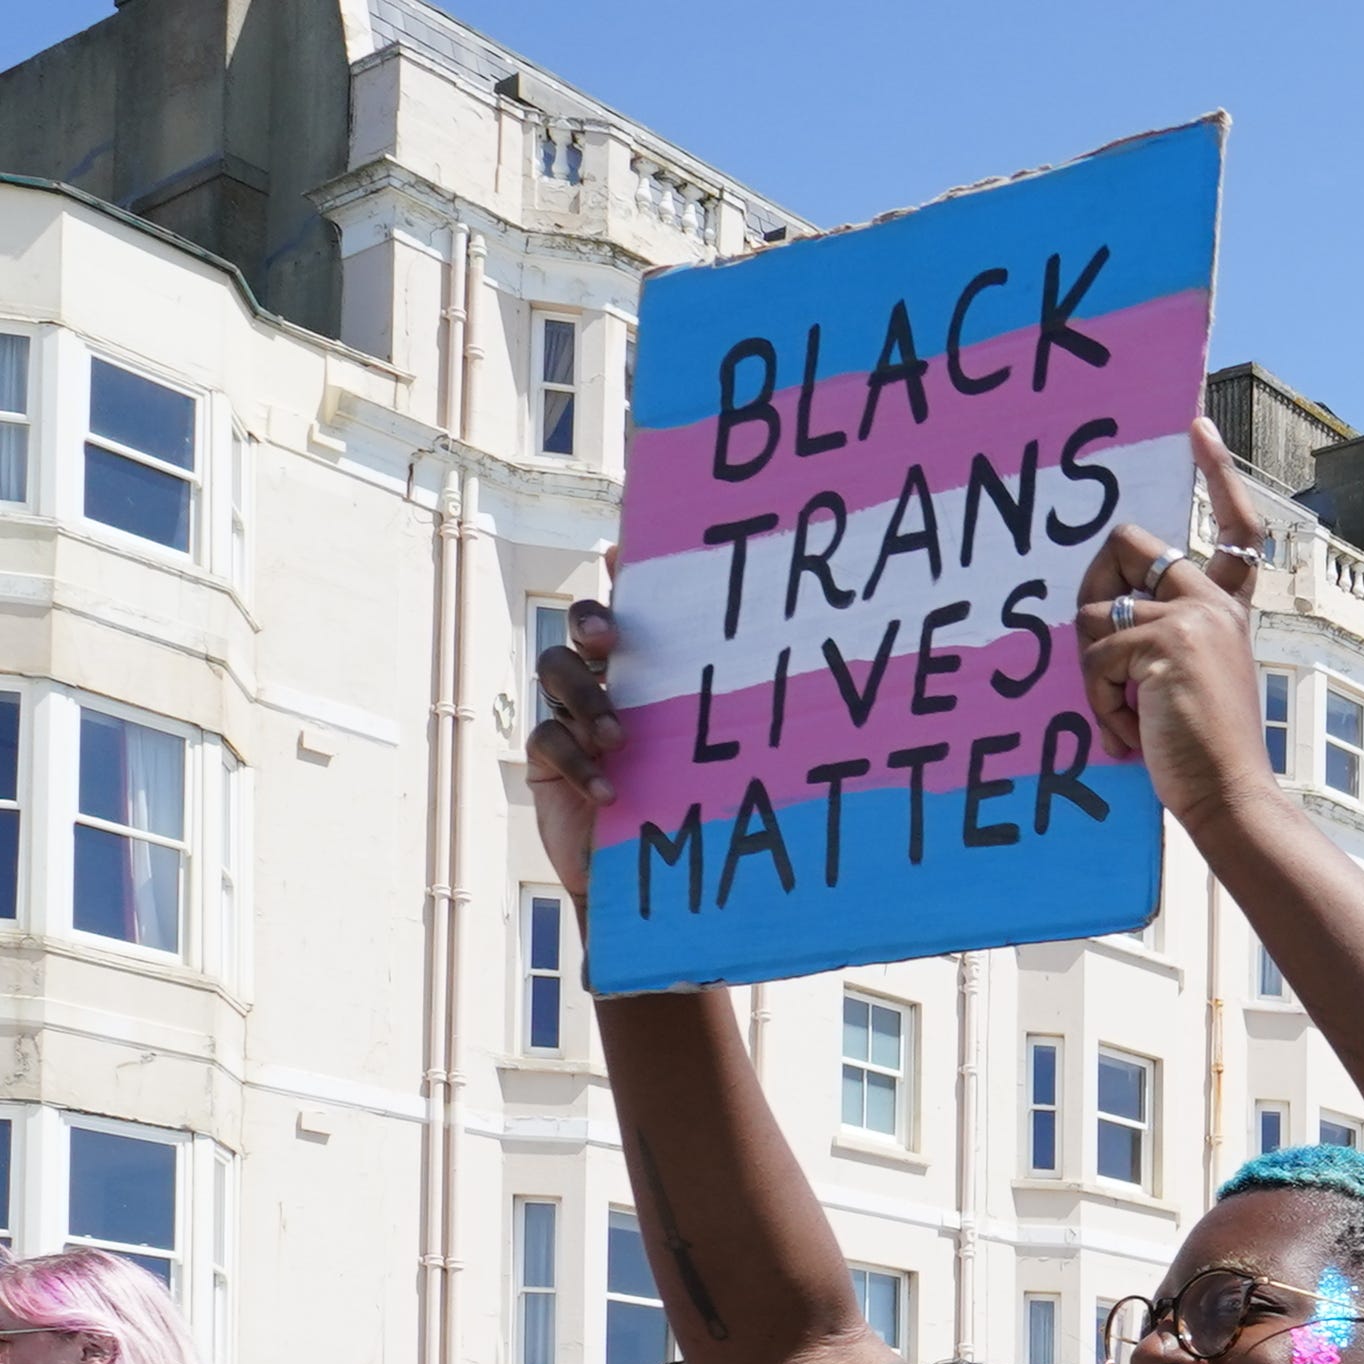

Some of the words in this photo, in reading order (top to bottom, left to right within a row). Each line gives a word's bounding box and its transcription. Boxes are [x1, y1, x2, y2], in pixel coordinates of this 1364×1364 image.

[712, 245, 1110, 482] BLACK
[703, 417, 1120, 640] TRANS
[692, 579, 1053, 763] LIVES
[638, 711, 1111, 919] MATTER
